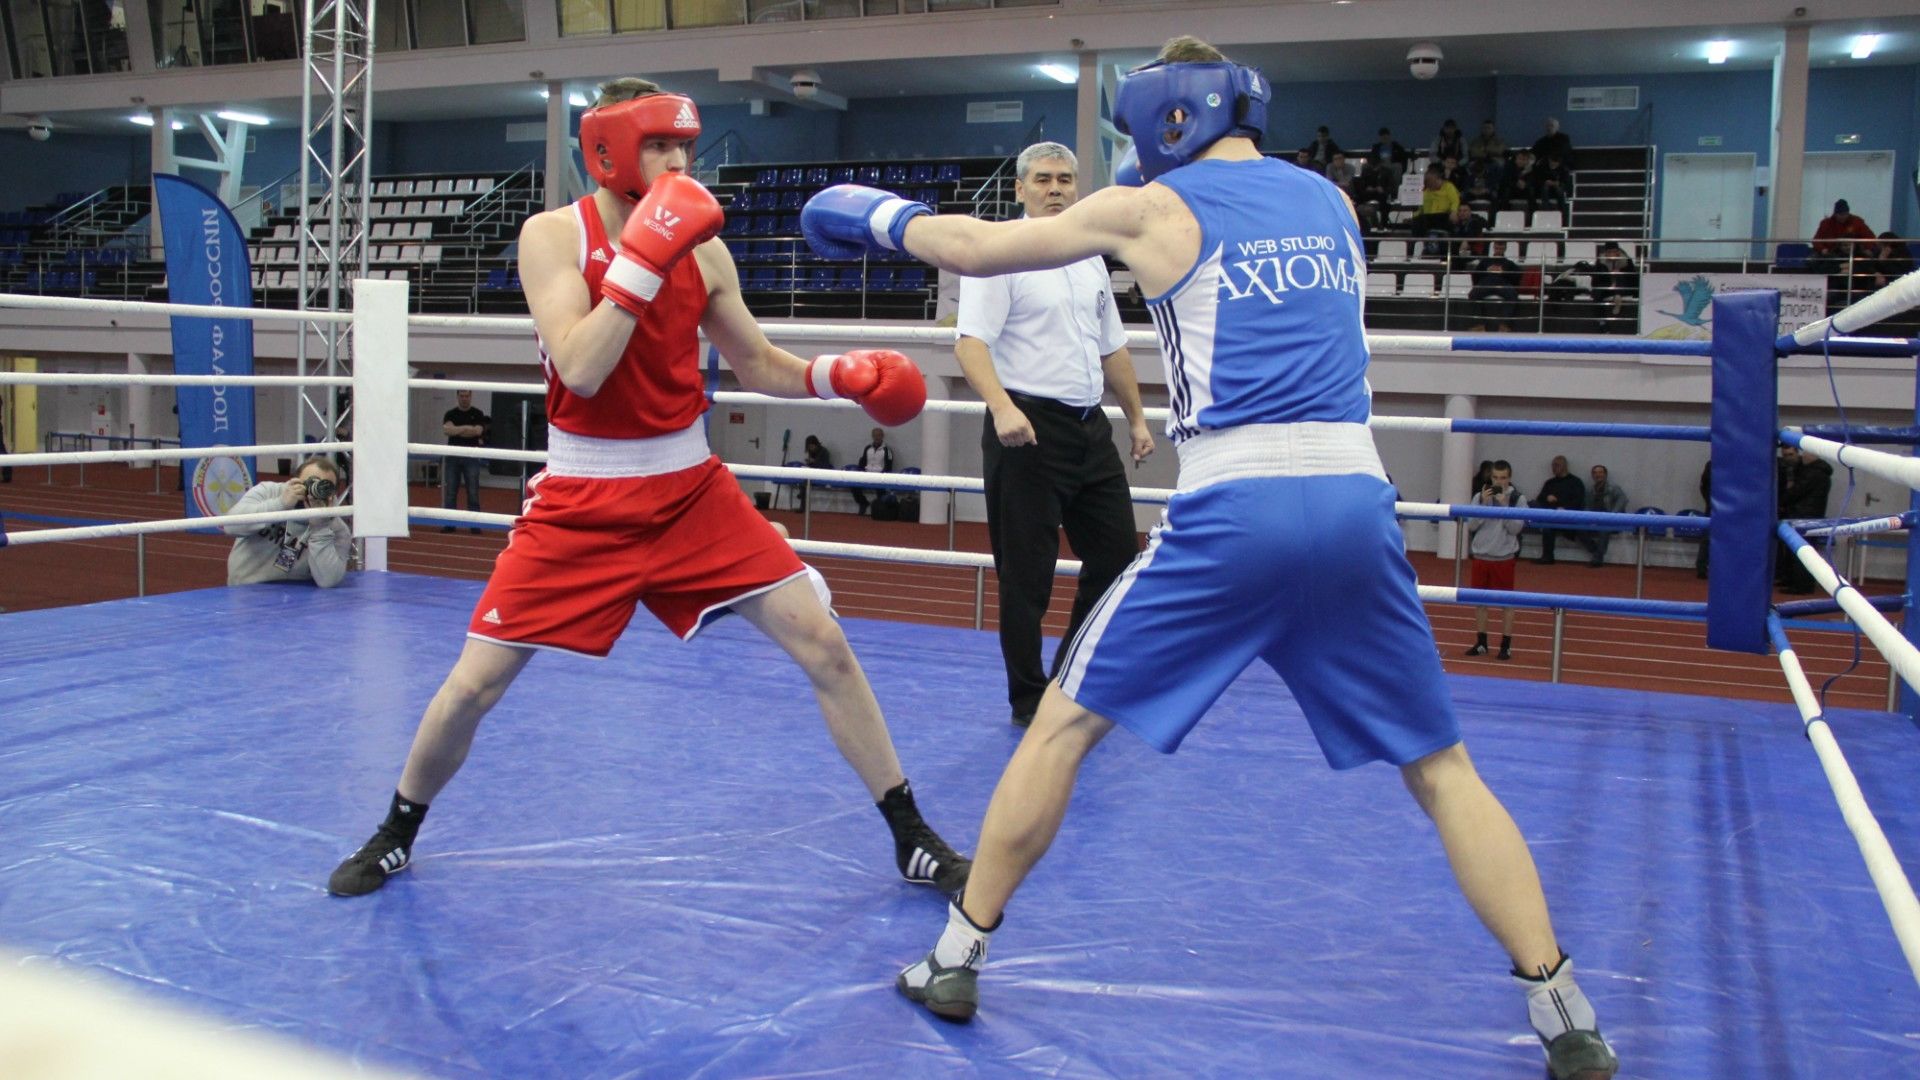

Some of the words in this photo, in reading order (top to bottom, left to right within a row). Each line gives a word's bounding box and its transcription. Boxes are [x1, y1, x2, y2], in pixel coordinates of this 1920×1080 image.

[1238, 240, 1277, 256] WEB
[1281, 235, 1336, 252] STUDIO
[1216, 253, 1360, 305] AXIOMA
